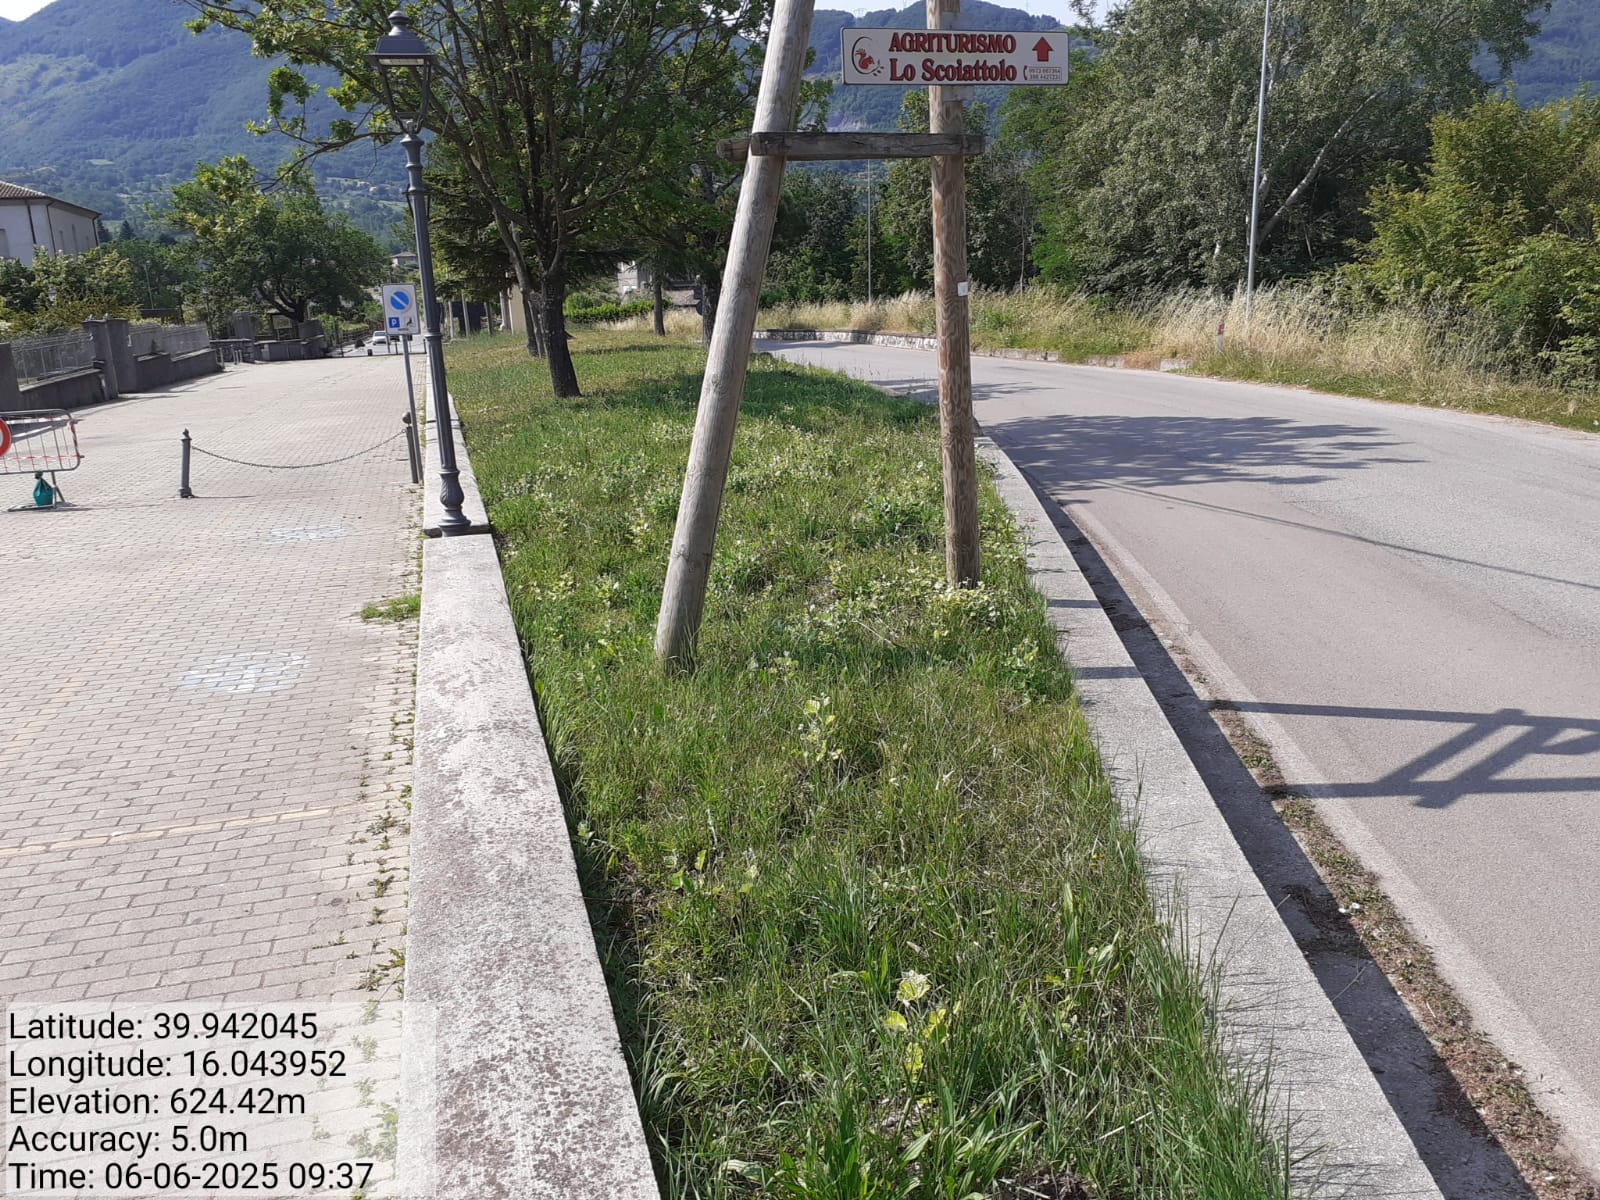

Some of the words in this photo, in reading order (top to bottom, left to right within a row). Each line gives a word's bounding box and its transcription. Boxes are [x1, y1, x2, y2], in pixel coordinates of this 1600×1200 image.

[888, 32, 1017, 54] AGRITURISMO
[889, 58, 916, 81] Lo
[921, 58, 1018, 81] Scoiattolo
